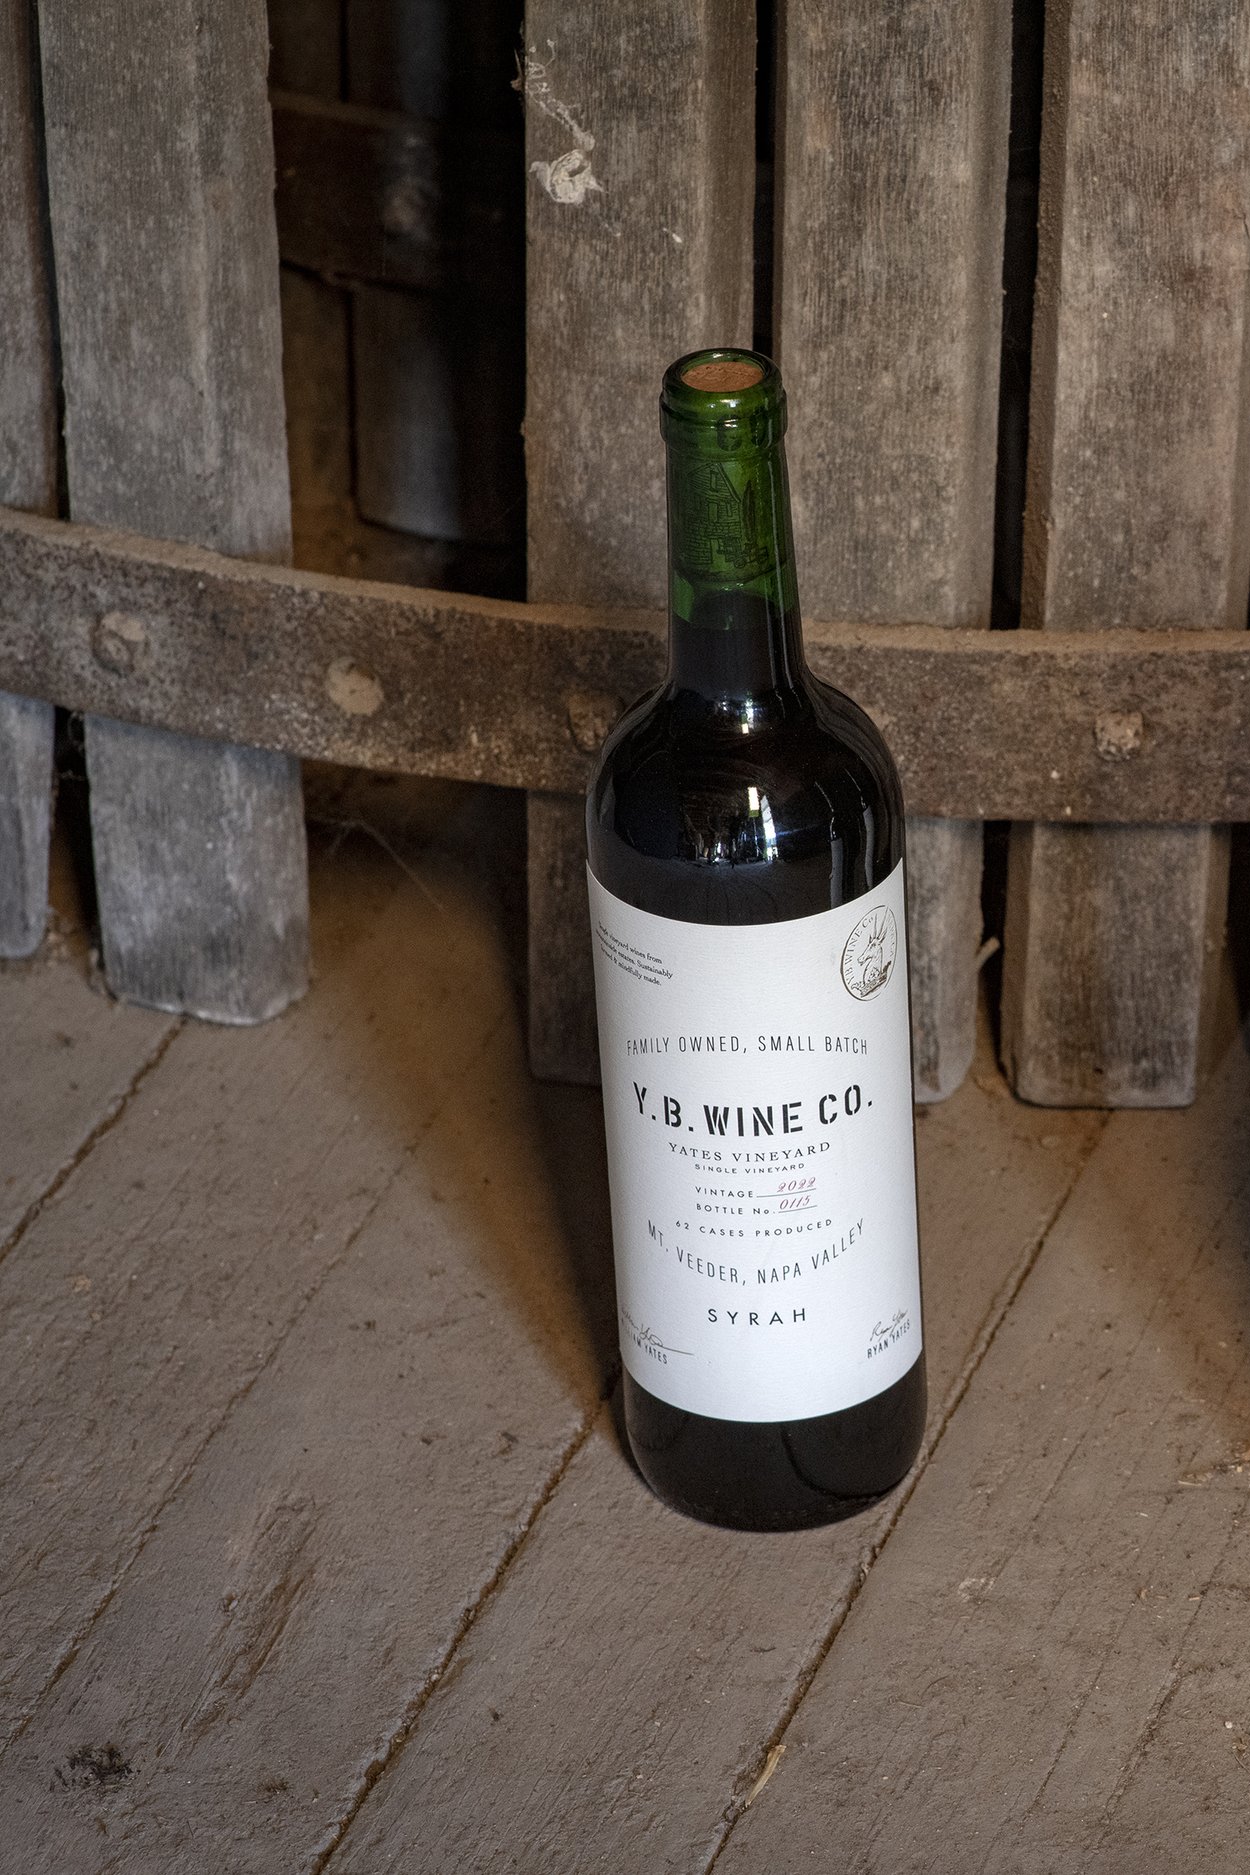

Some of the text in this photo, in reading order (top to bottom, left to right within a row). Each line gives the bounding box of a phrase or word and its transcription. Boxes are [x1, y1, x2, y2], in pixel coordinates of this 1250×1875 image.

[609, 933, 628, 951] vineyard
[630, 946, 646, 959] wines
[647, 953, 662, 964] from
[845, 930, 862, 965] WINE
[618, 962, 642, 980] mindfully
[644, 975, 661, 986] made.
[637, 960, 673, 979] Sustainably
[627, 1035, 867, 1056] FAMILY OWNED, SMALL BATCH
[703, 1101, 803, 1137] WINE
[819, 1084, 872, 1125] CO.
[668, 1142, 830, 1162] YATES VINEYARD
[695, 1163, 804, 1174] SINGLE VINEYARD
[695, 1177, 816, 1198] VINTAGE 2022
[696, 1196, 811, 1215] BOTTLE No. 0115
[675, 1219, 832, 1237] 62 CASES PRODUCED
[648, 1218, 863, 1286] MT. VEEDER, NAPA VALLEY
[708, 1308, 805, 1325] SYRAH
[867, 1338, 888, 1359] RYAN
[892, 1319, 910, 1343] YATES
[645, 1345, 667, 1364] YATES
